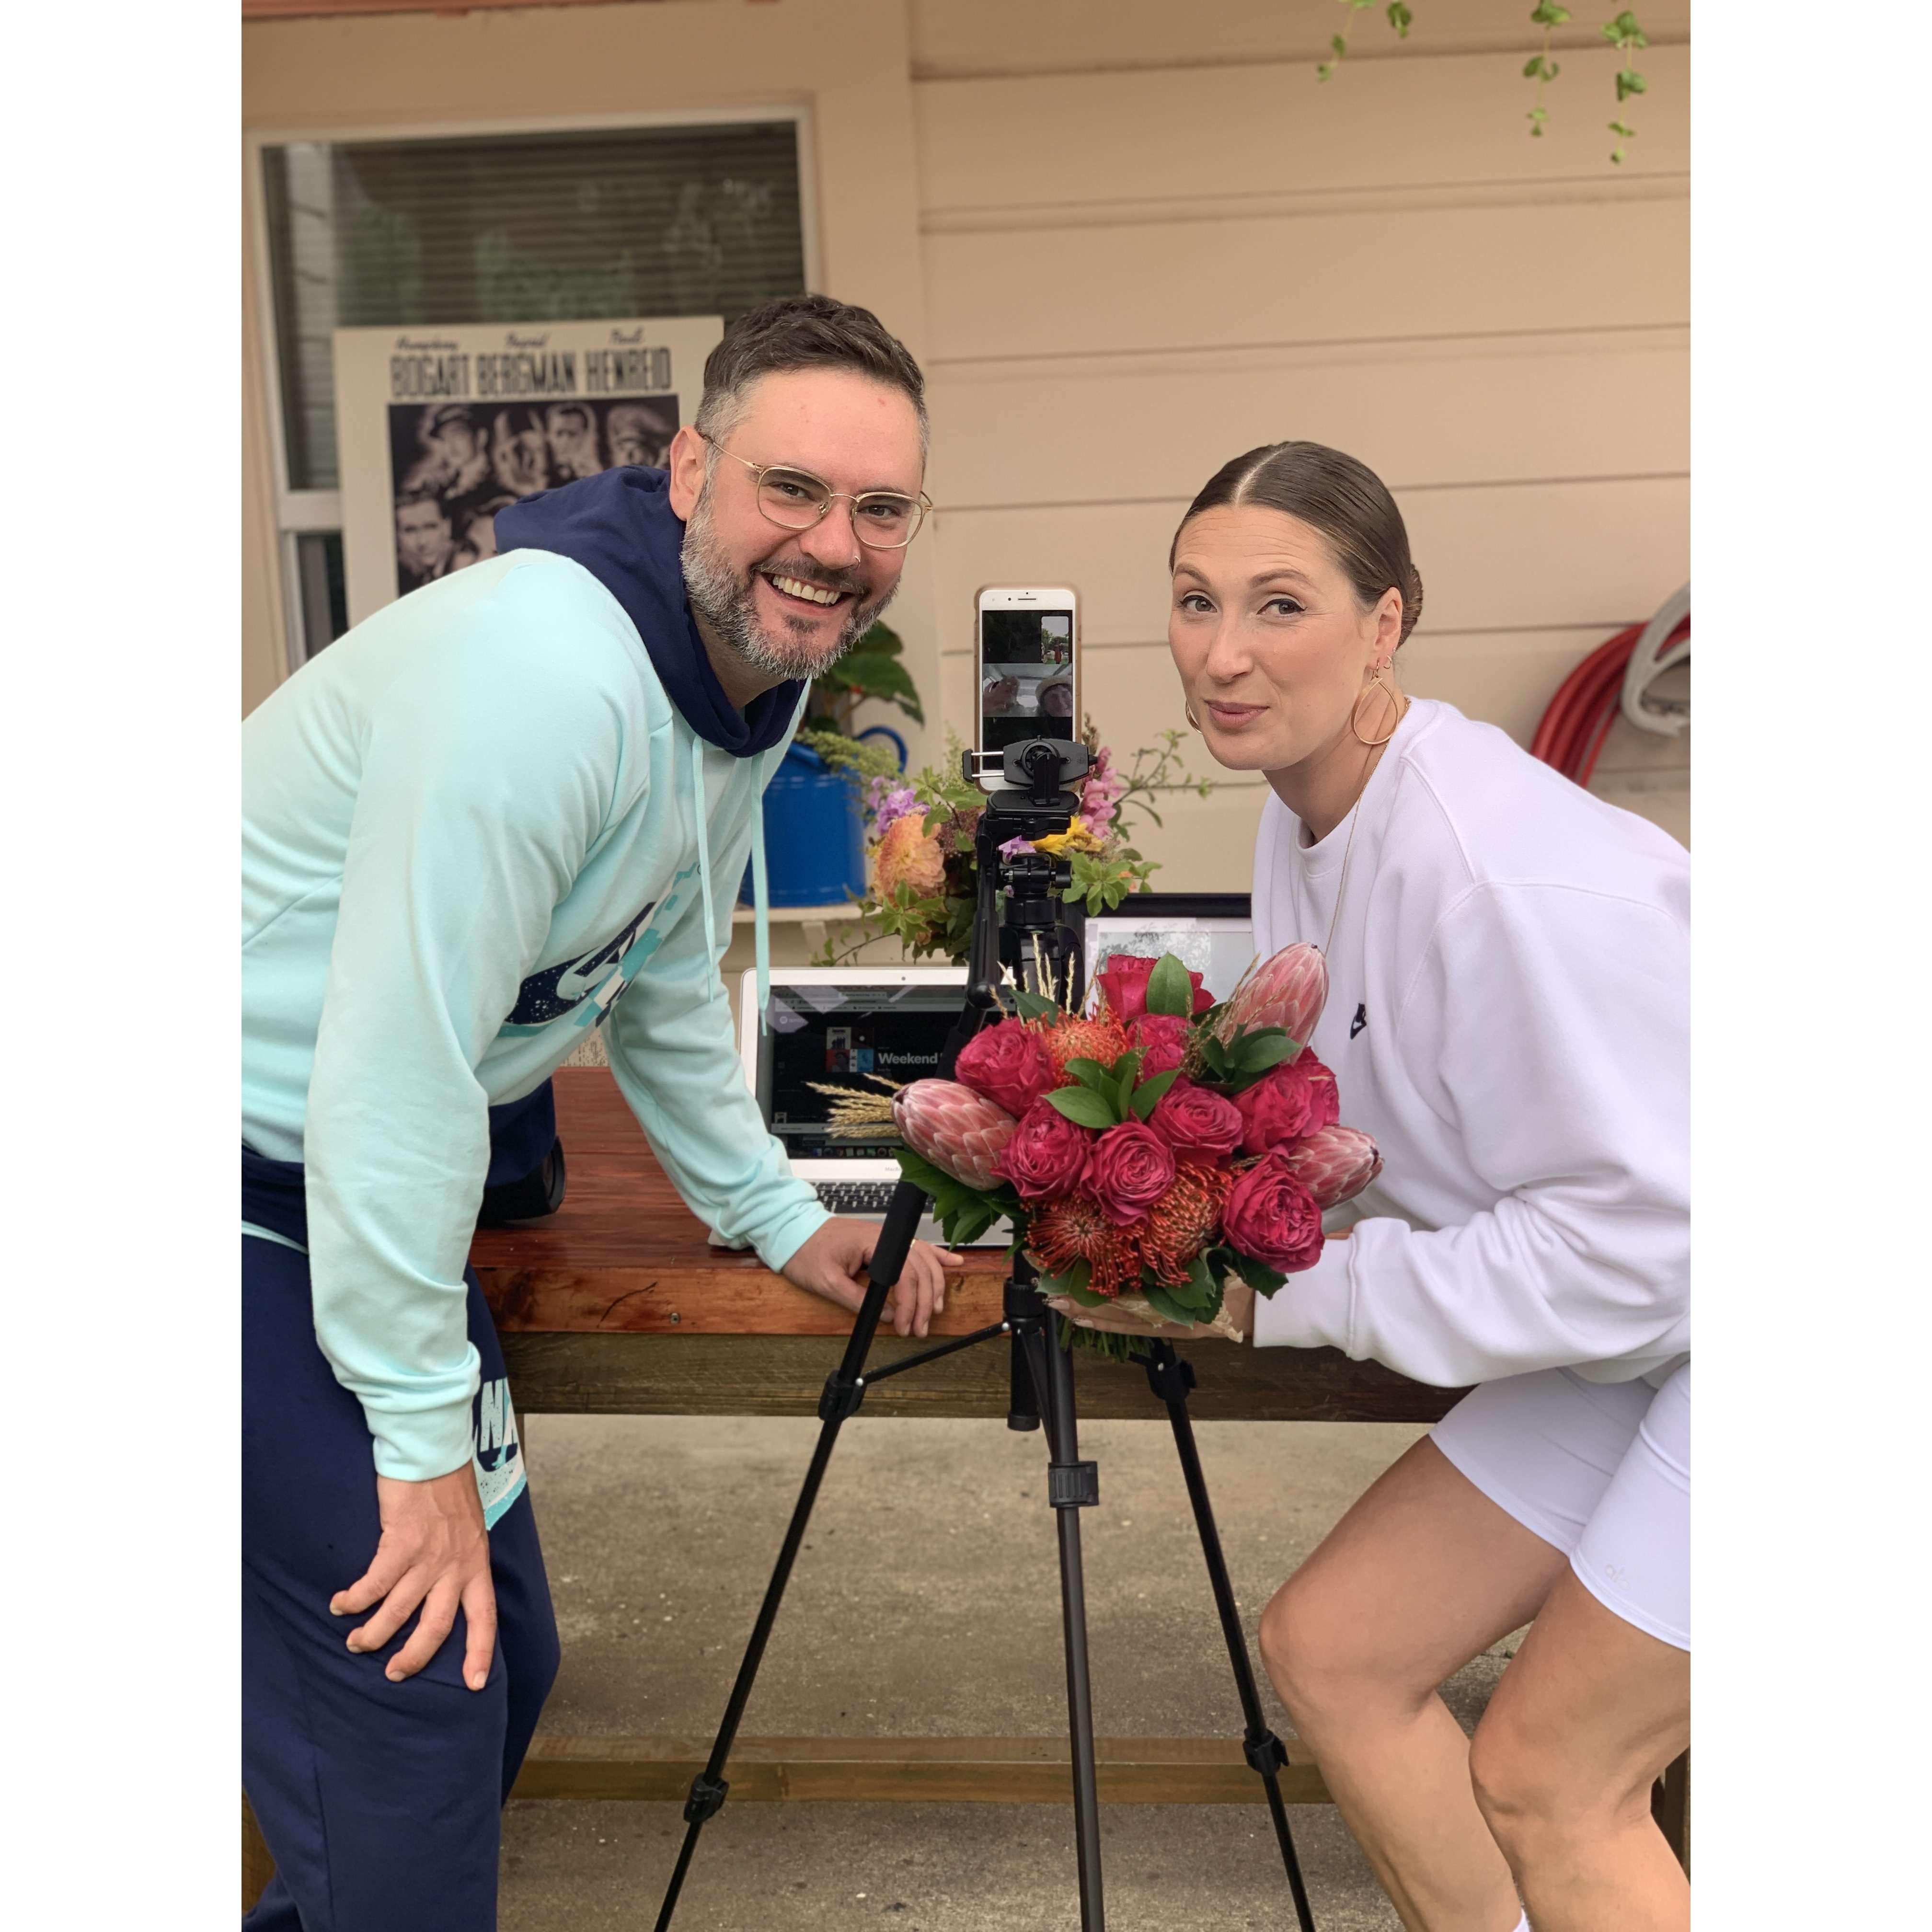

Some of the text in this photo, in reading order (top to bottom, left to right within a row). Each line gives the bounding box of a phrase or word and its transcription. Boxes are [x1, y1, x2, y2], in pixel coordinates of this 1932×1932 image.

[391, 347, 672, 396] BOGART BERGMAN HENREID
[878, 1052, 938, 1064] Weekend
